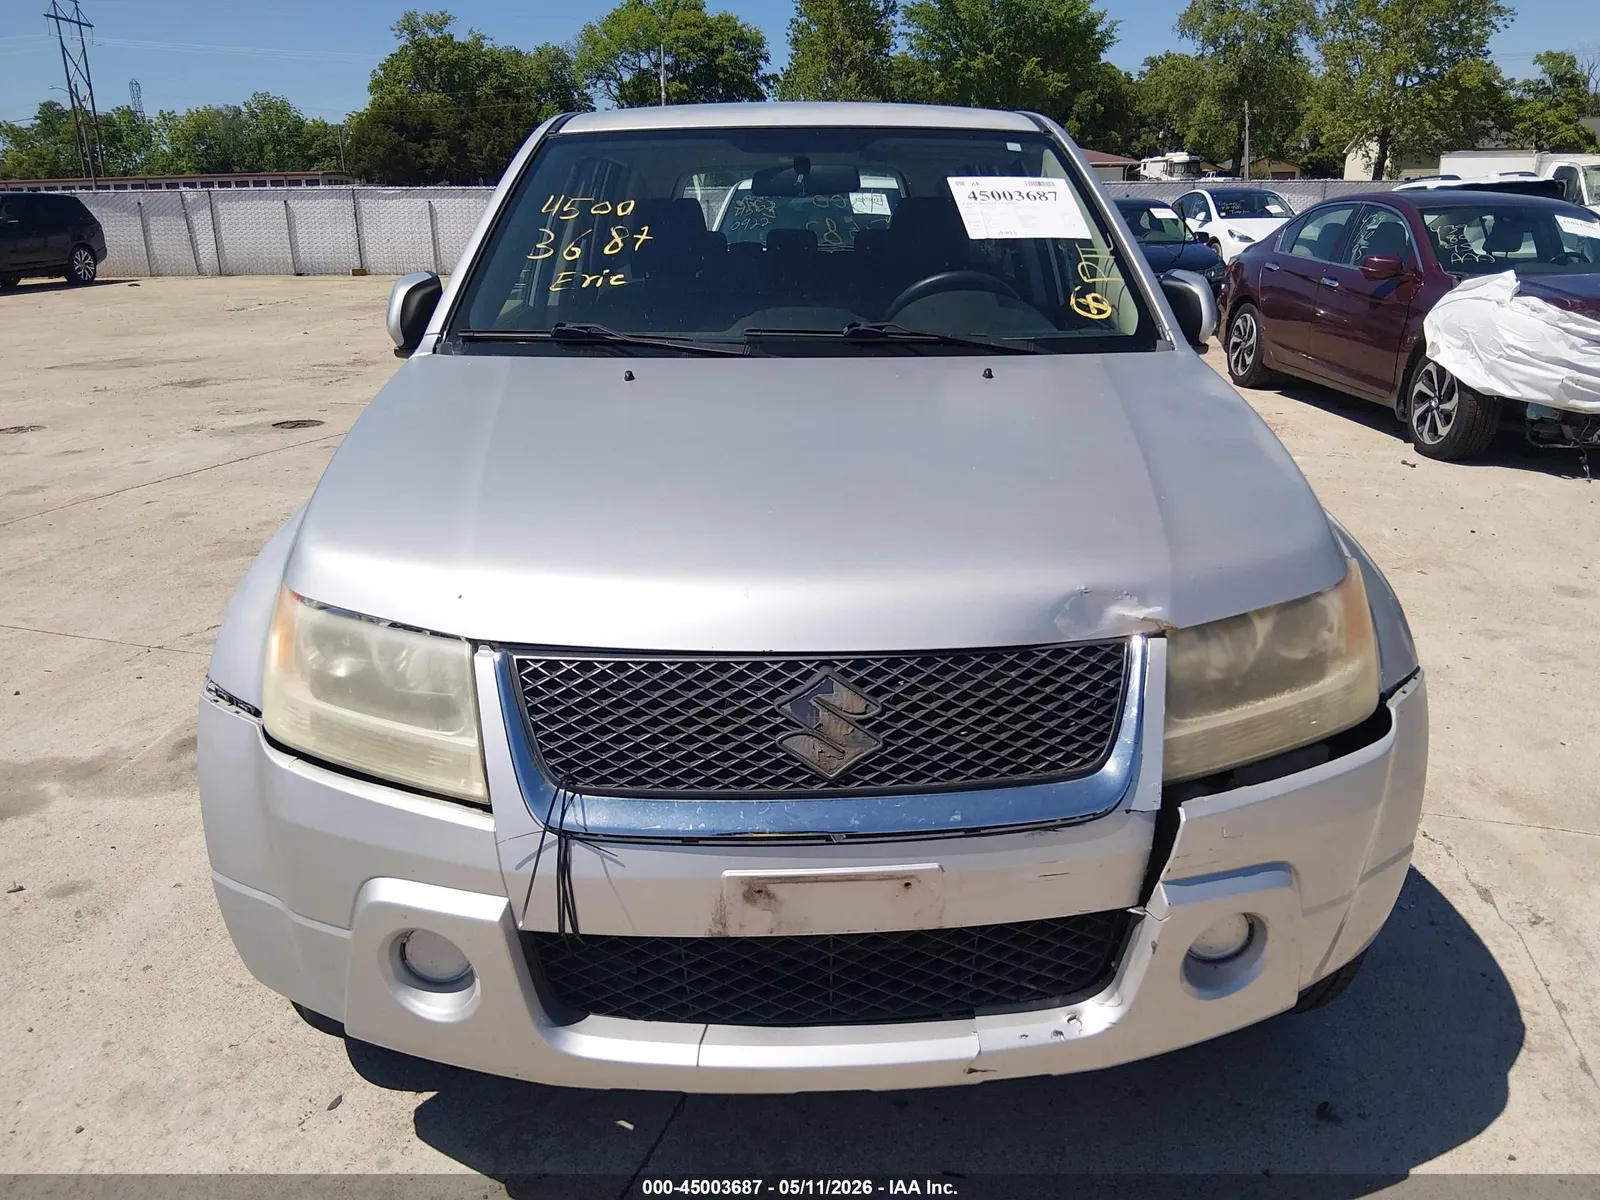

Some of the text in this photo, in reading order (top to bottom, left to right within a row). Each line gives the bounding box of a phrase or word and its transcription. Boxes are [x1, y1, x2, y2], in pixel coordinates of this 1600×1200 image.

[541, 195, 635, 219] 4500
[967, 190, 1058, 202] 45003687
[549, 269, 627, 291] Eric
